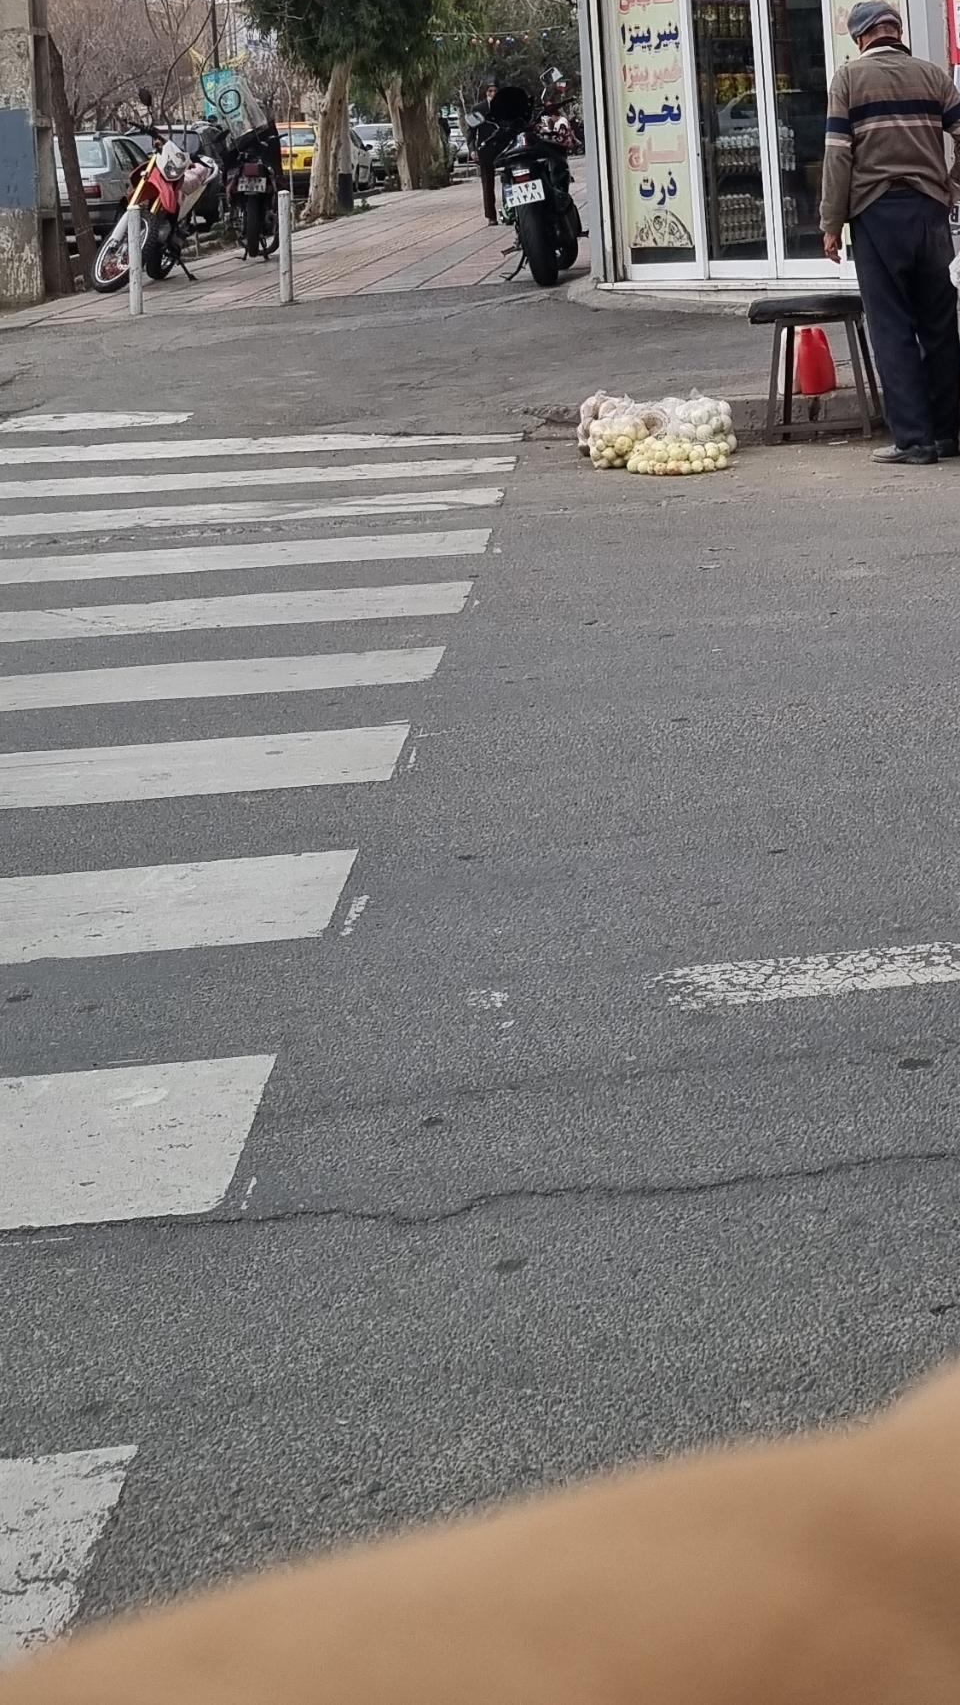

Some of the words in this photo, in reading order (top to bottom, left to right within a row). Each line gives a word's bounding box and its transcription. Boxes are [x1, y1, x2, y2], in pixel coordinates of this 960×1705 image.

[620, 22, 653, 53] پیتزا
[654, 20, 681, 51] پنیر
[622, 62, 650, 91] پیتزا
[626, 94, 682, 133] نخود
[639, 170, 678, 206] ذرت
